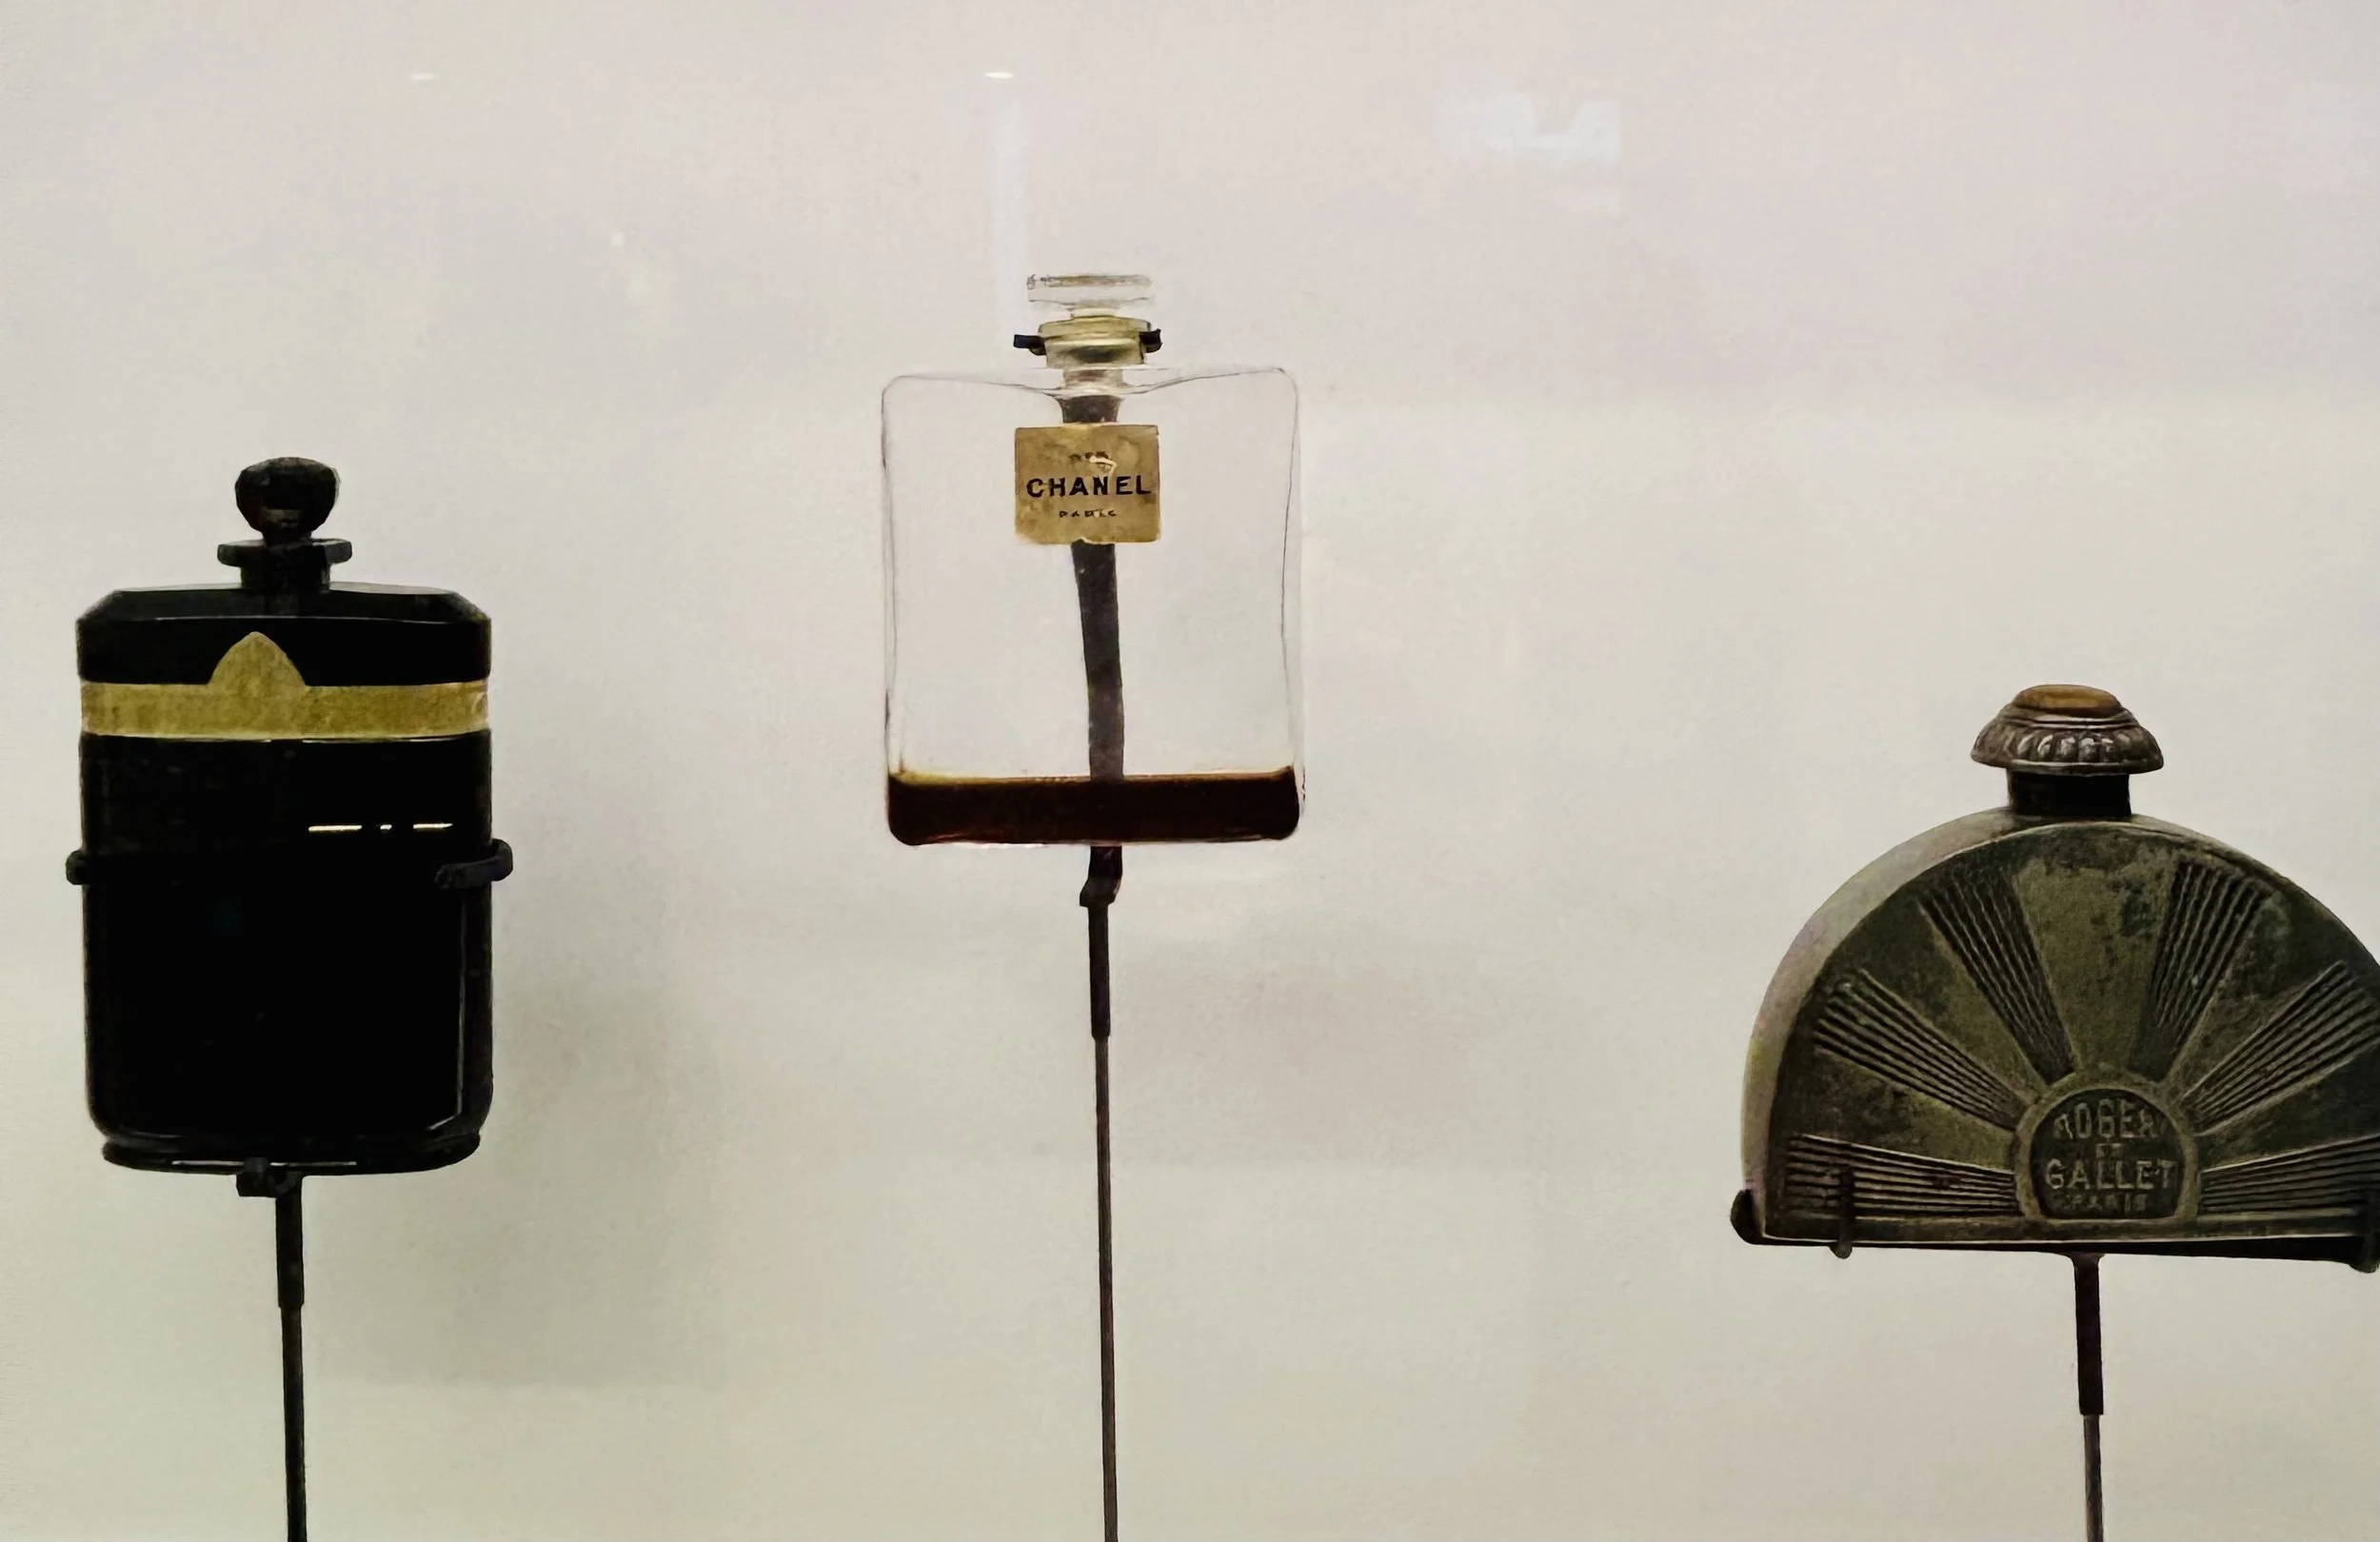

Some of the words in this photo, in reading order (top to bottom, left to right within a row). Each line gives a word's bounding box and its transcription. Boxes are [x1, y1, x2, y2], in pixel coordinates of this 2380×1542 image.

[1026, 475, 1152, 498] CHANEL
[2053, 1098, 2159, 1139] ROGER
[2046, 1157, 2178, 1190] GALLET
